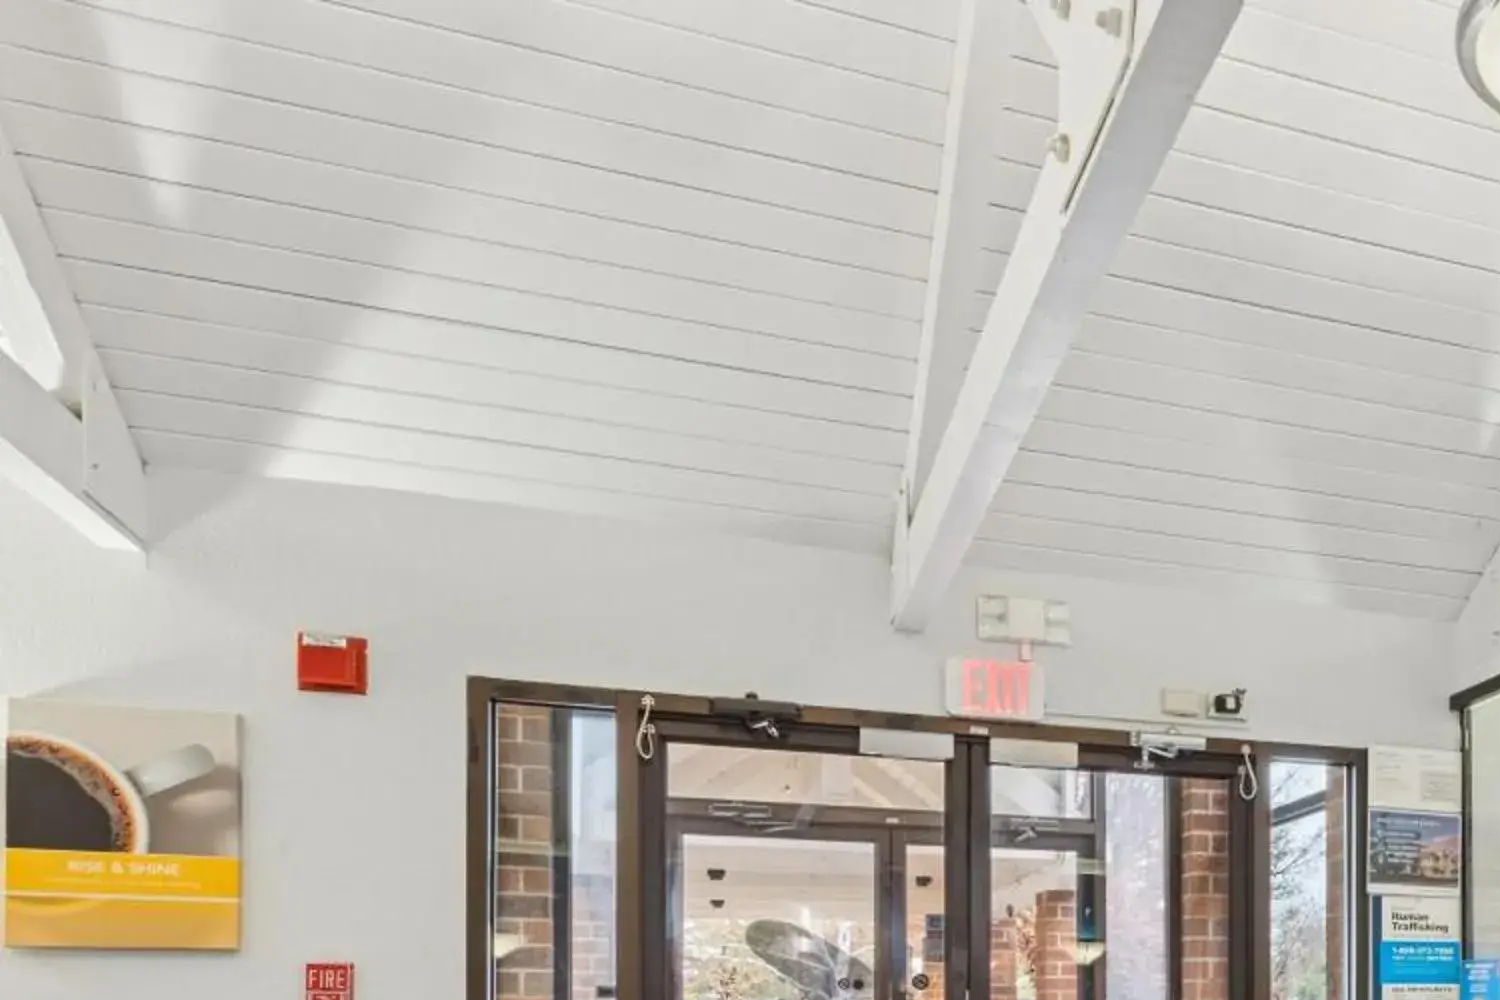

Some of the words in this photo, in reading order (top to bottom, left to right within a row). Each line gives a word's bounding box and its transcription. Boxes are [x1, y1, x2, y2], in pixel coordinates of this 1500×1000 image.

[963, 660, 1030, 713] EXIT
[1391, 911, 1429, 921] Human
[1391, 922, 1450, 934] Trafficking
[308, 969, 346, 989] FIRE
